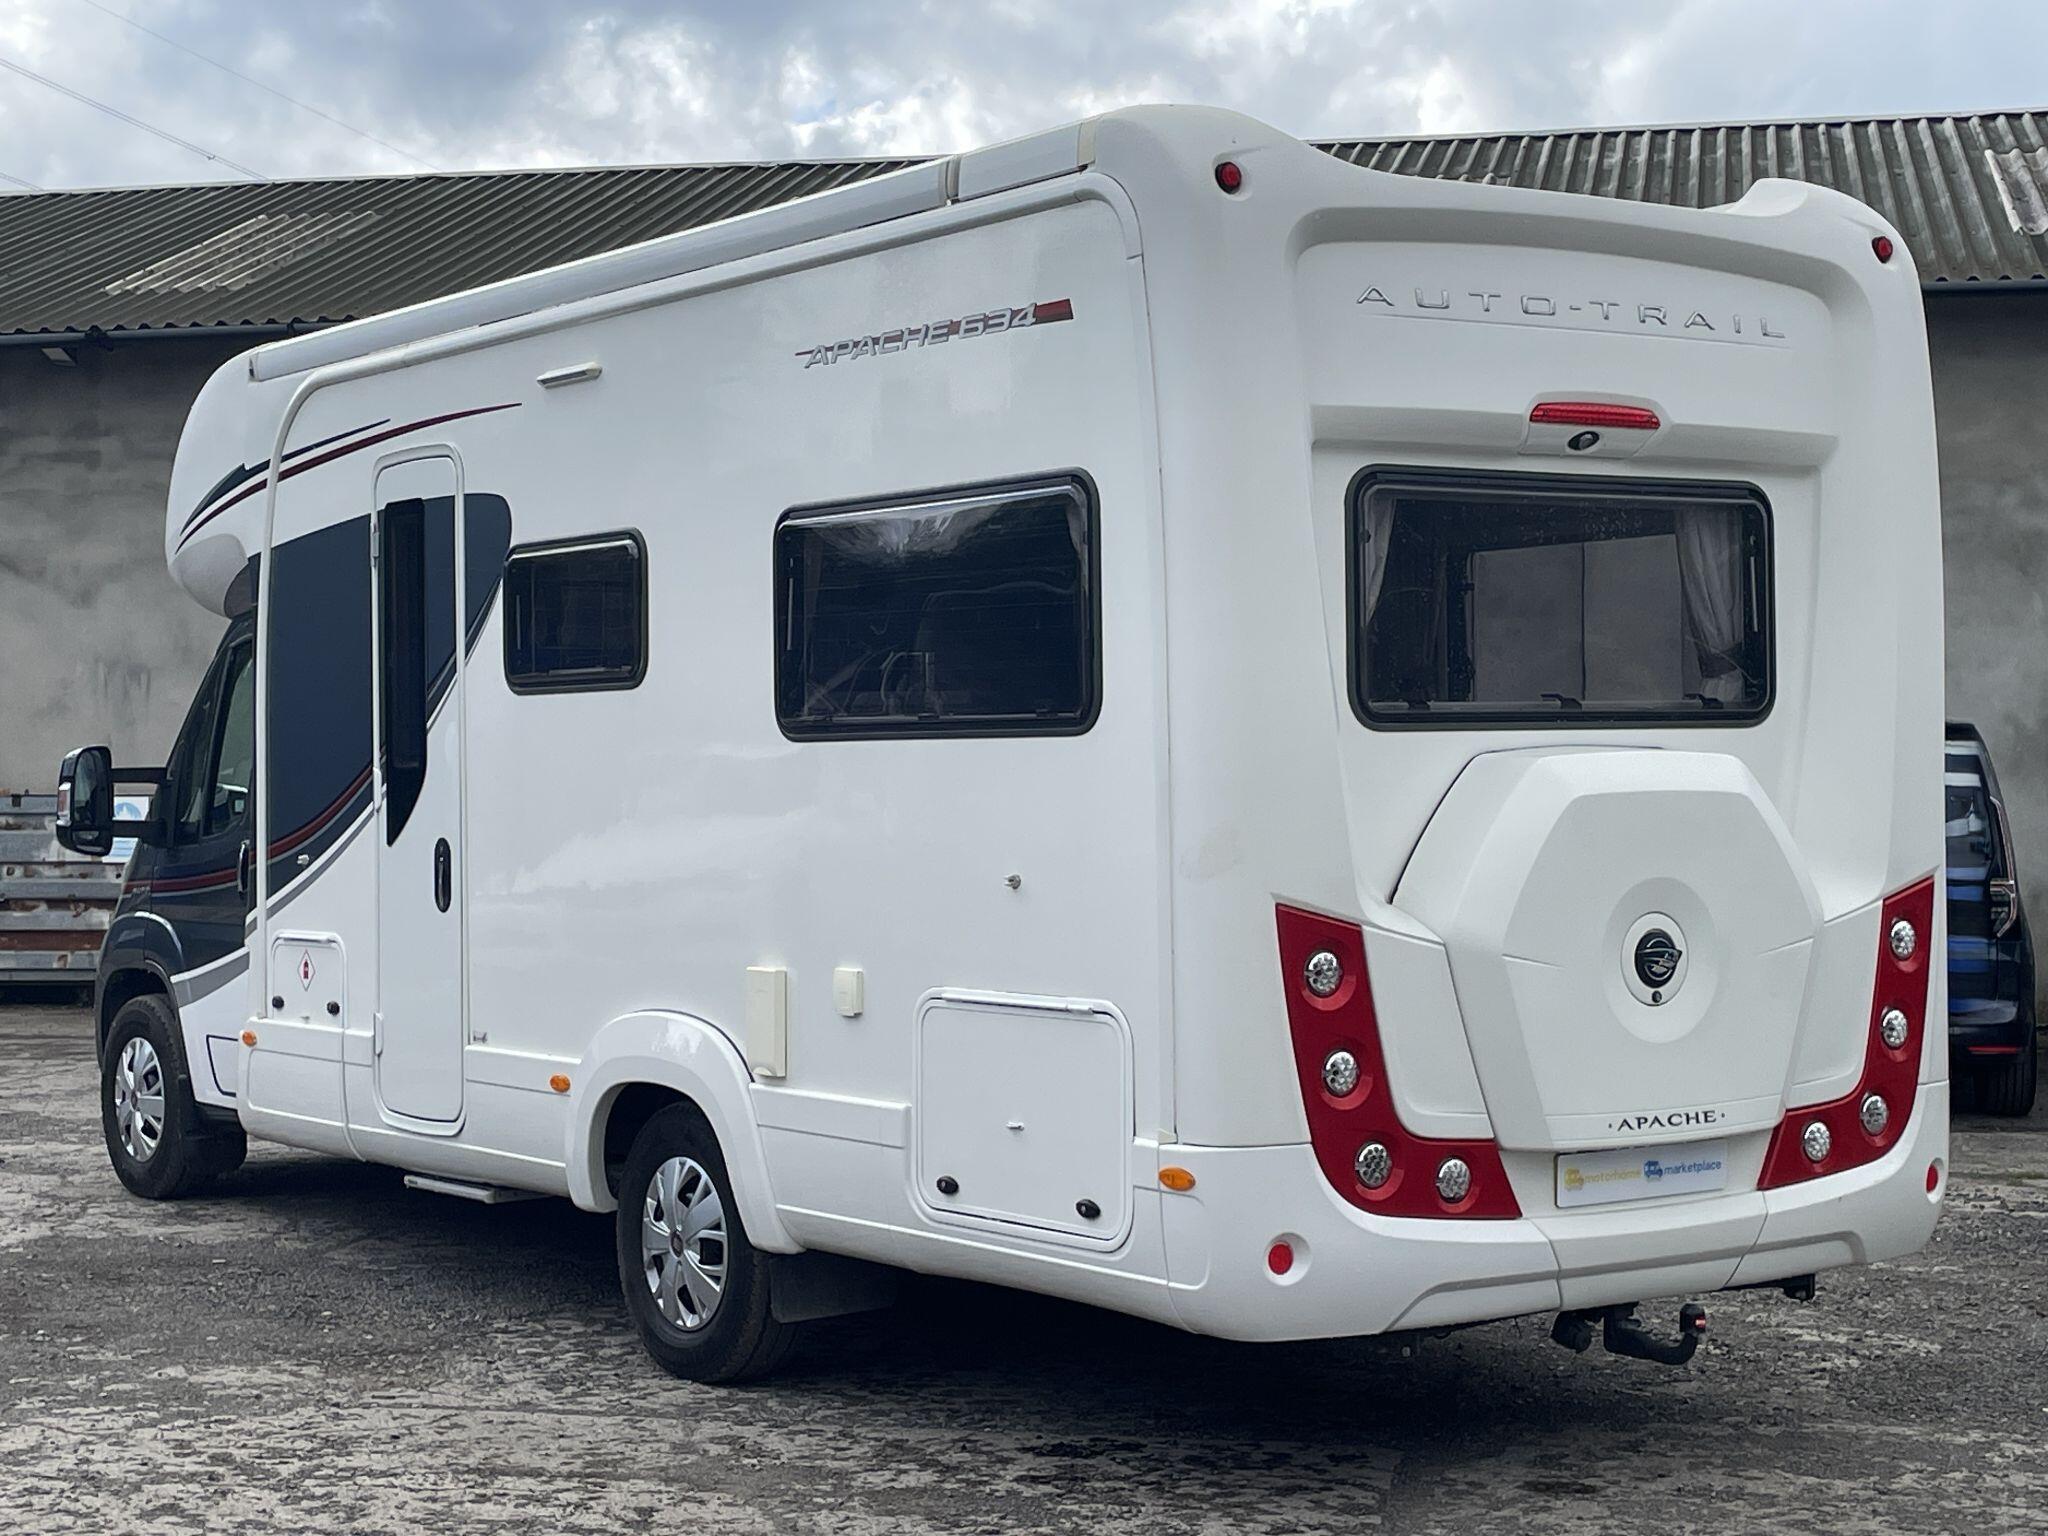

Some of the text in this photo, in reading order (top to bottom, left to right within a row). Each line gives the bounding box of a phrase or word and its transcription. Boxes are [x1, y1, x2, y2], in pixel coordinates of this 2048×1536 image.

[1356, 284, 1786, 339] AUTO-TRAIL
[804, 303, 1038, 368] APACHE 634
[1617, 1110, 1717, 1132] APACHE
[1584, 1160, 1722, 1184] motorhome marketplace
